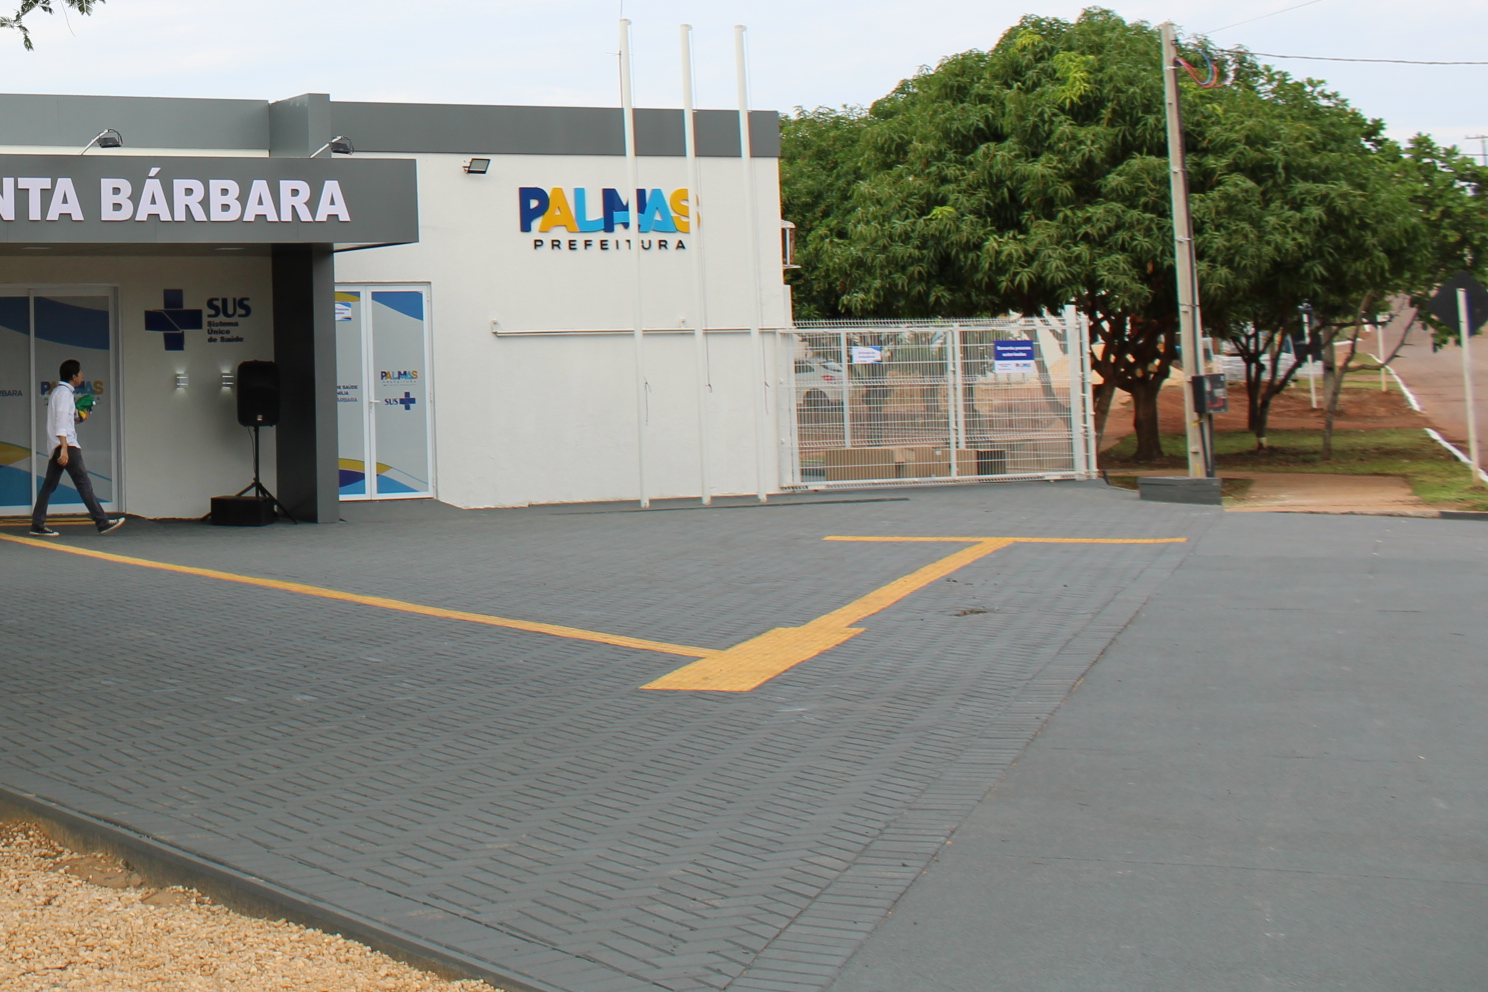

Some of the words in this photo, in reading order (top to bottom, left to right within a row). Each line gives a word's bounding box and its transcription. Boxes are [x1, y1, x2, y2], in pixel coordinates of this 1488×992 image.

[100, 167, 351, 223] BÁRBARA
[518, 186, 701, 234] PALMAS
[533, 239, 687, 250] PREFEITURA
[206, 297, 252, 319] SUS
[207, 320, 239, 328] Sistema
[207, 326, 231, 335] Único
[380, 370, 419, 380] PALMAS
[383, 398, 399, 406] SUS
